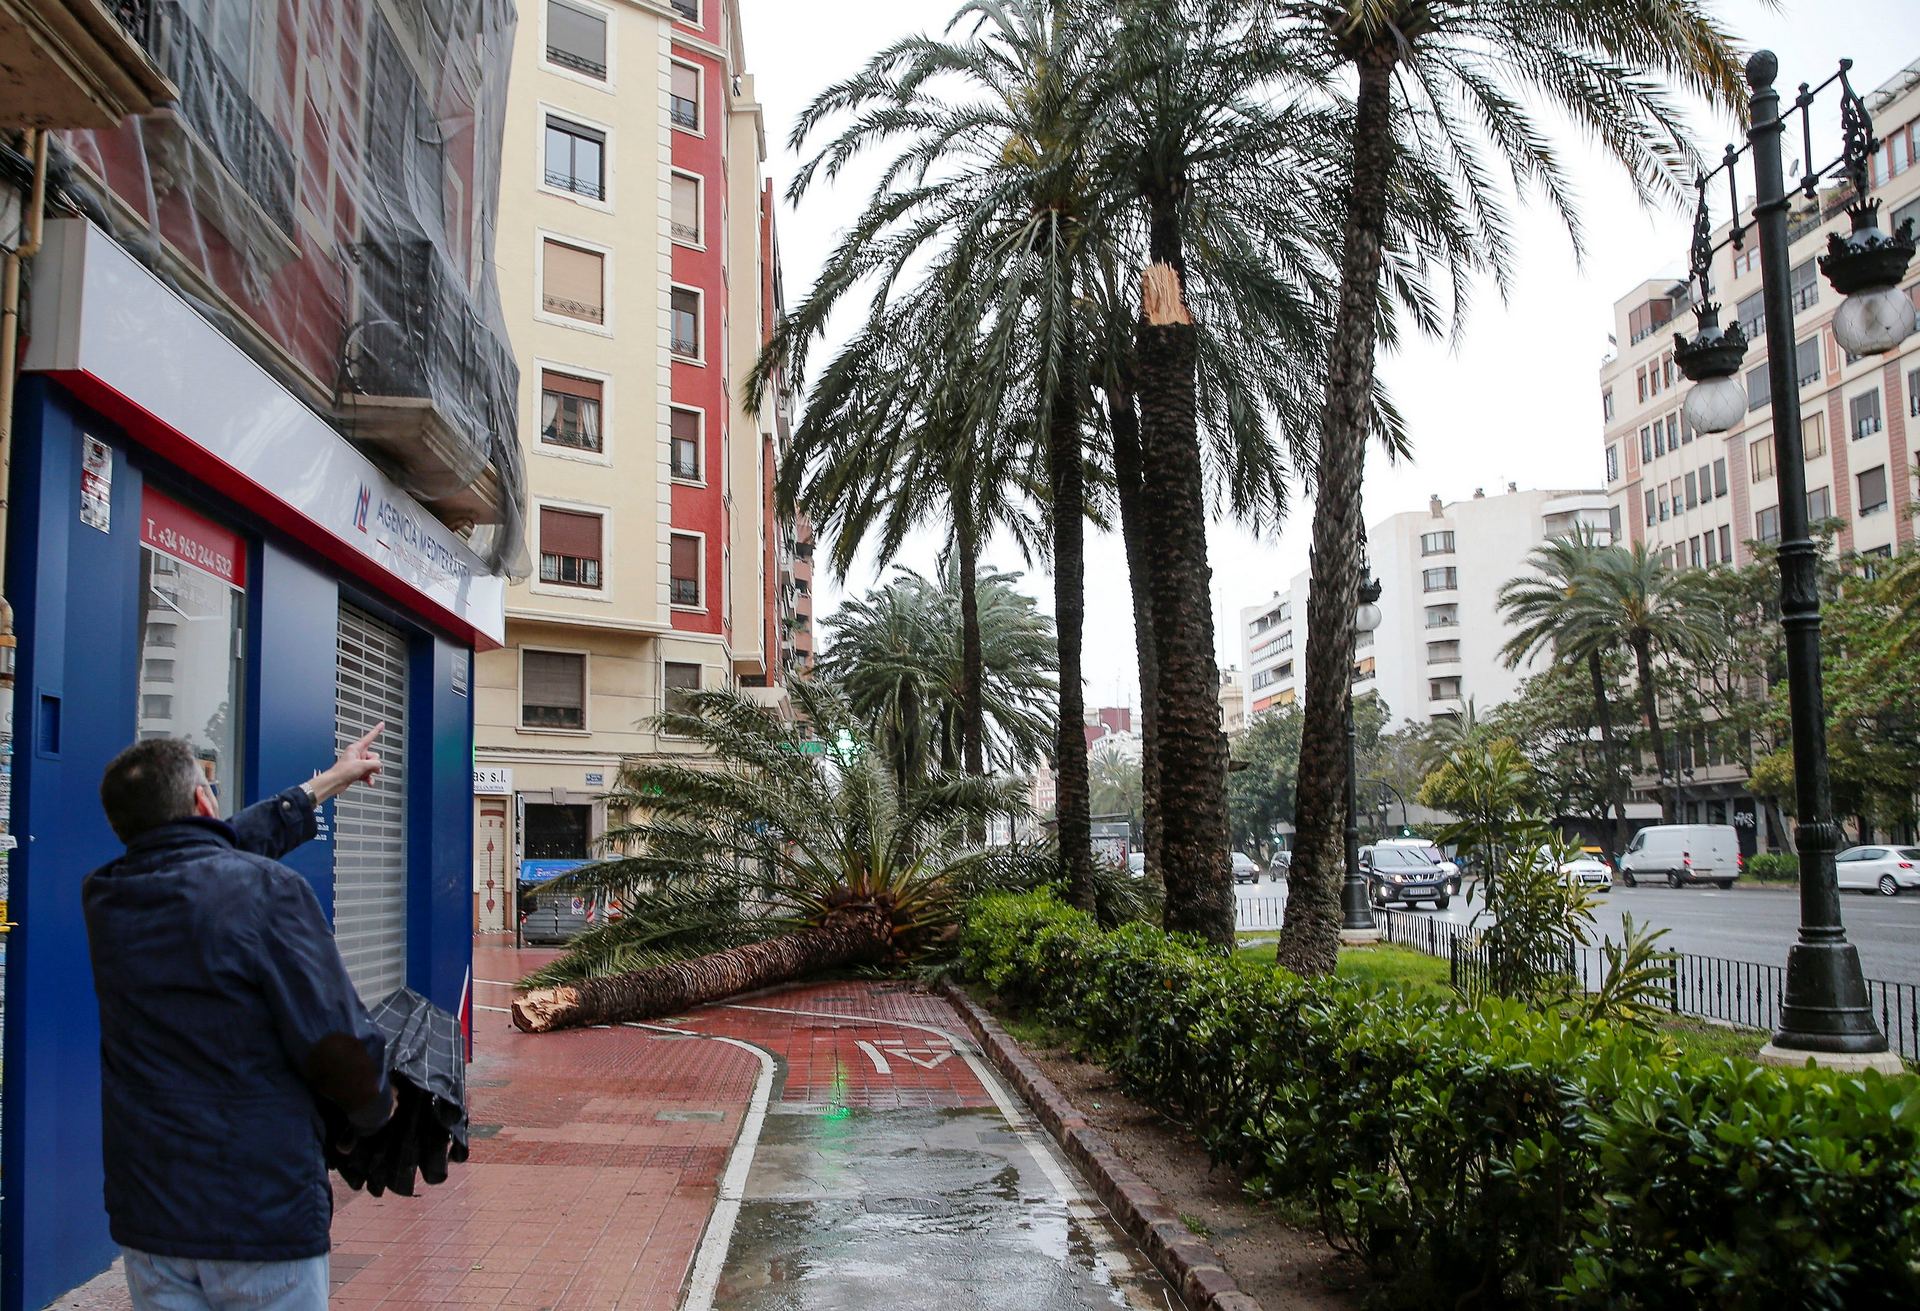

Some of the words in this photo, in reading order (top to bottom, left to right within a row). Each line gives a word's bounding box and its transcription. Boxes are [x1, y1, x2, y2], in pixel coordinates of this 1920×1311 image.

[147, 518, 157, 542] T.
[159, 528, 177, 551] +34
[179, 535, 197, 560] 963
[377, 500, 417, 549] AGENCIA
[490, 769, 506, 783] s.l.
